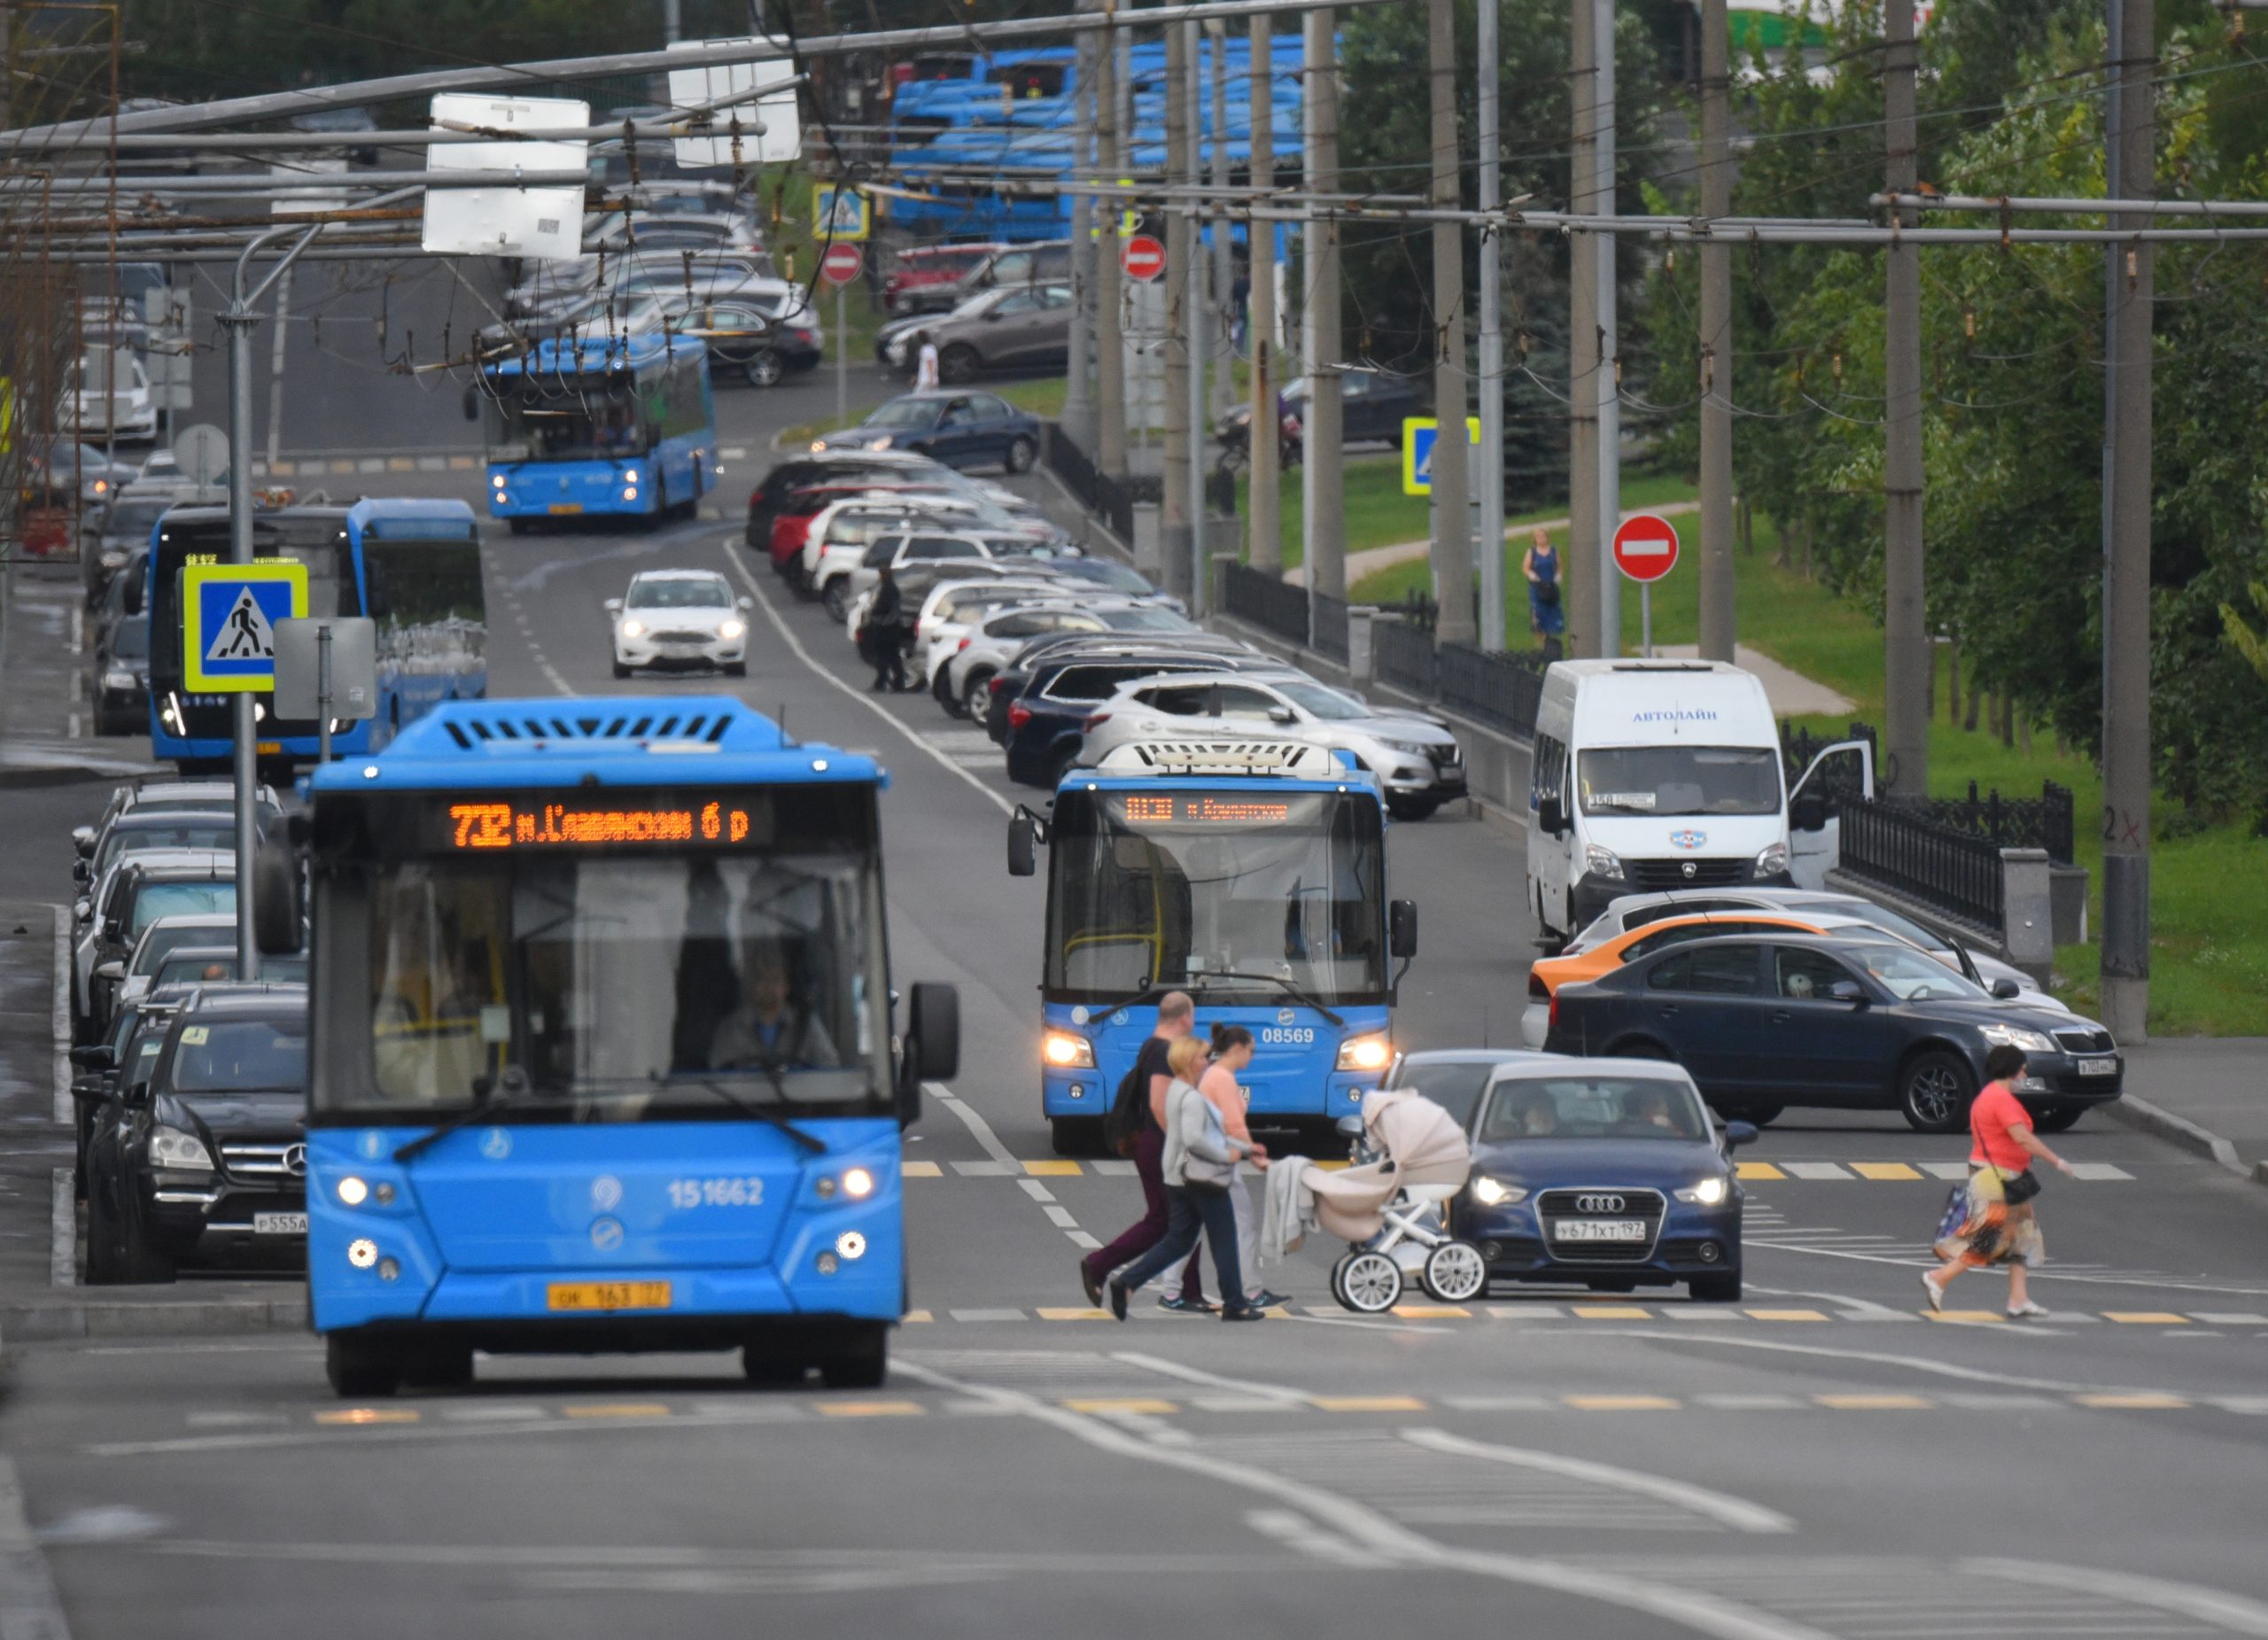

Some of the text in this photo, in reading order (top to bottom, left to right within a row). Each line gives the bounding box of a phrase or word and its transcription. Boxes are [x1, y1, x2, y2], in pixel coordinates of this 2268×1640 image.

[1633, 709, 1717, 722] АВТОЛАЙН
[1262, 1028, 1314, 1043] 08569
[669, 1178, 764, 1208] 151662
